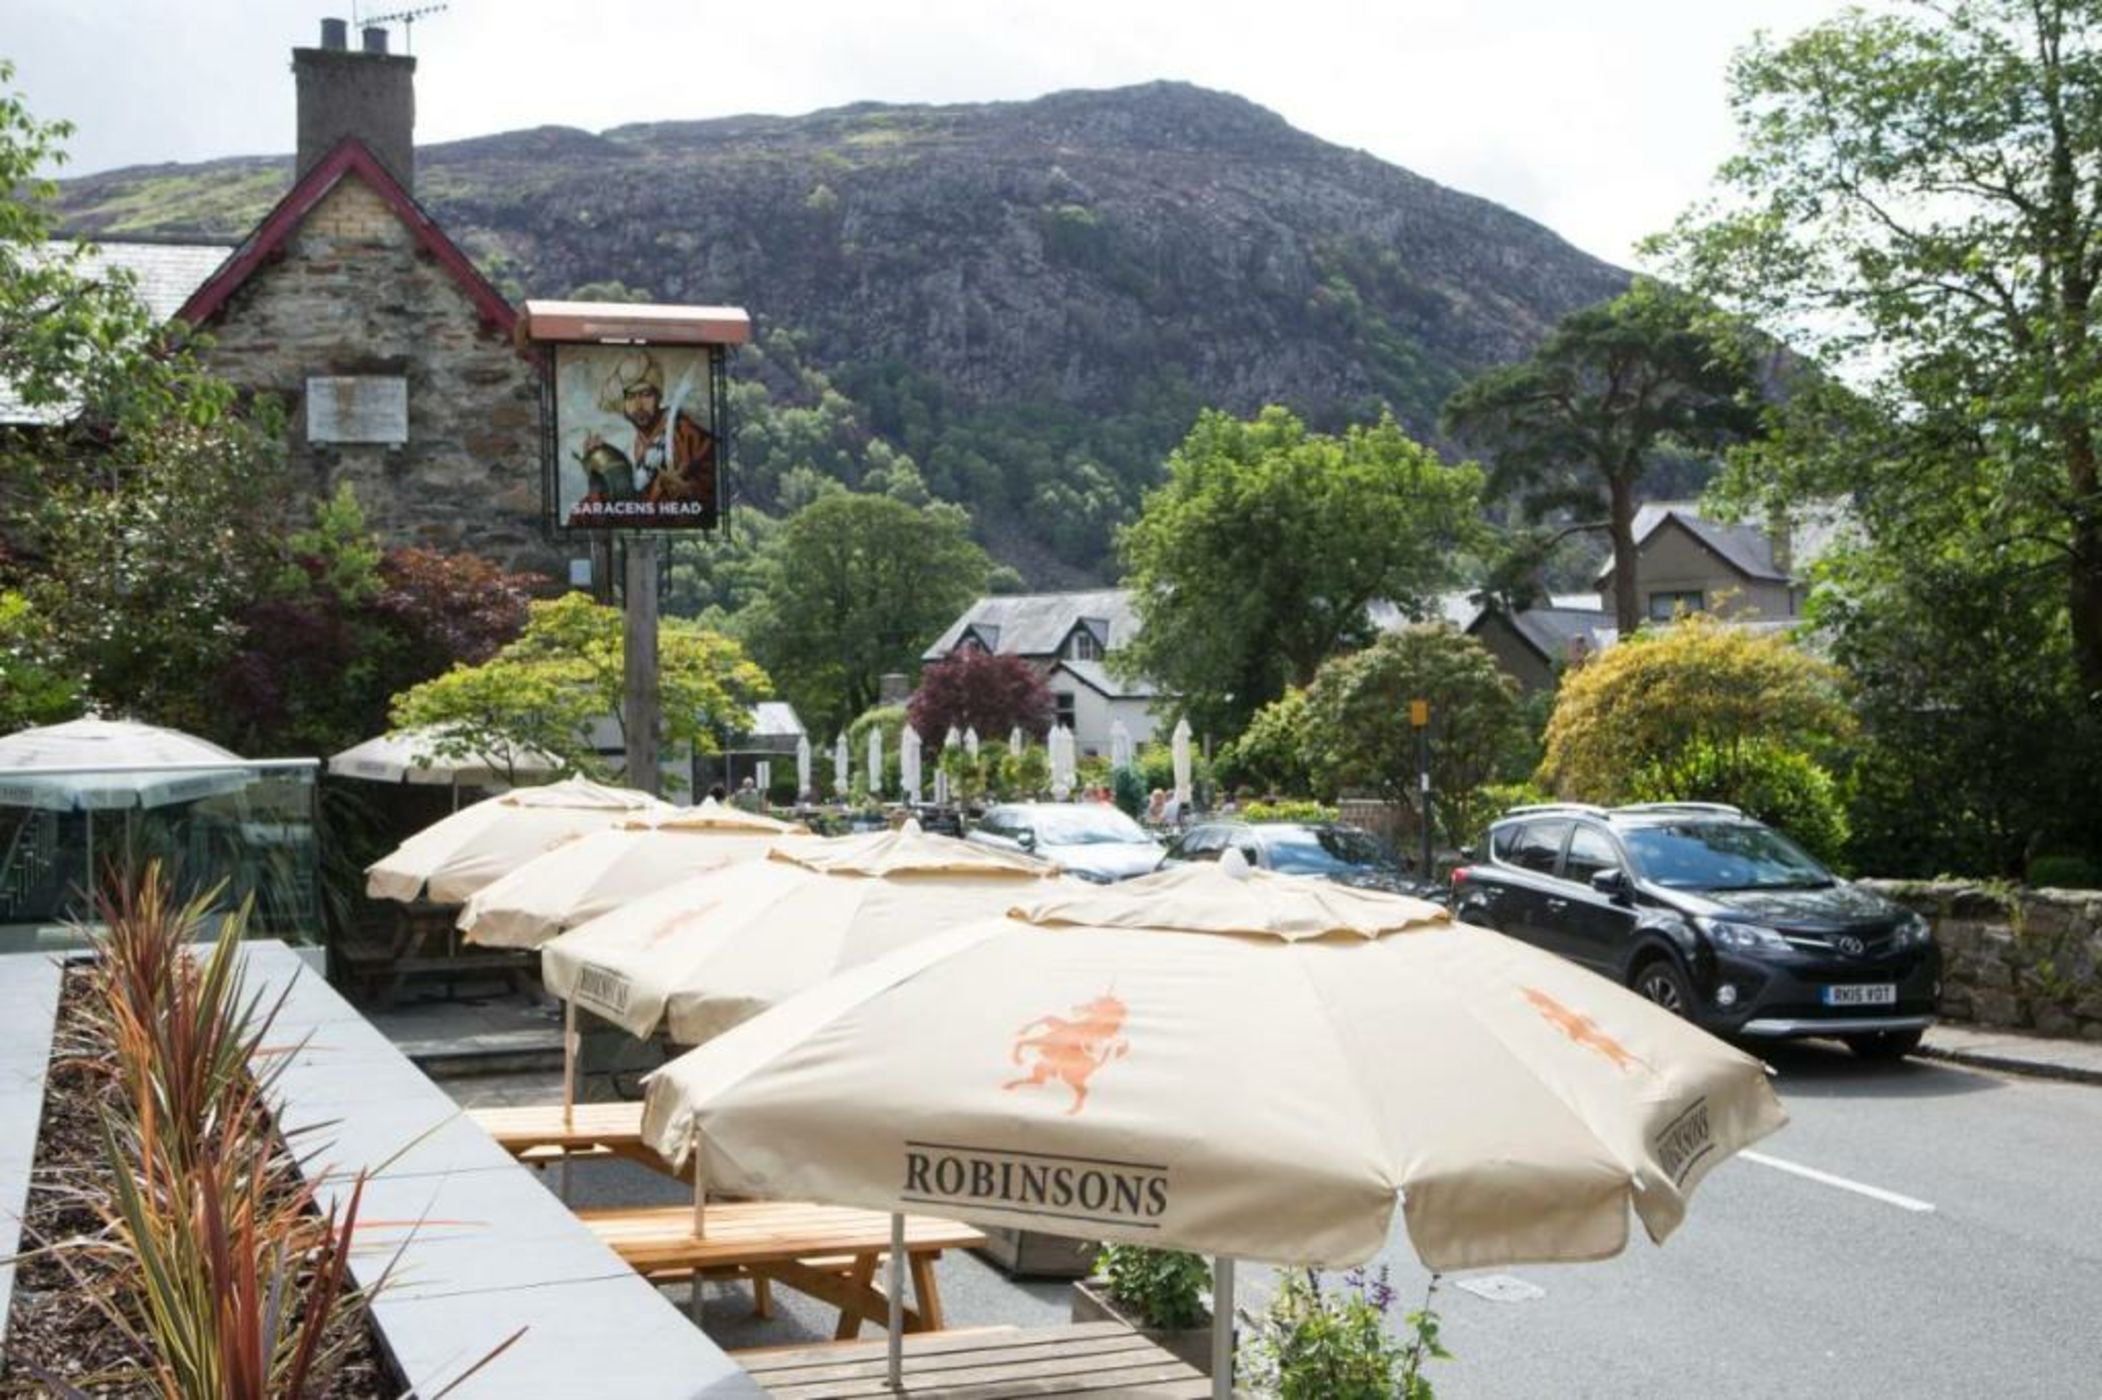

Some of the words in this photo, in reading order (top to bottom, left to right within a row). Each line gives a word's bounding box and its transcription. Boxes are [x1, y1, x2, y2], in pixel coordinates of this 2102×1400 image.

[570, 501, 655, 515] SARACENS
[659, 501, 702, 515] HEAD
[903, 1152, 1168, 1217] ROBINSONS
